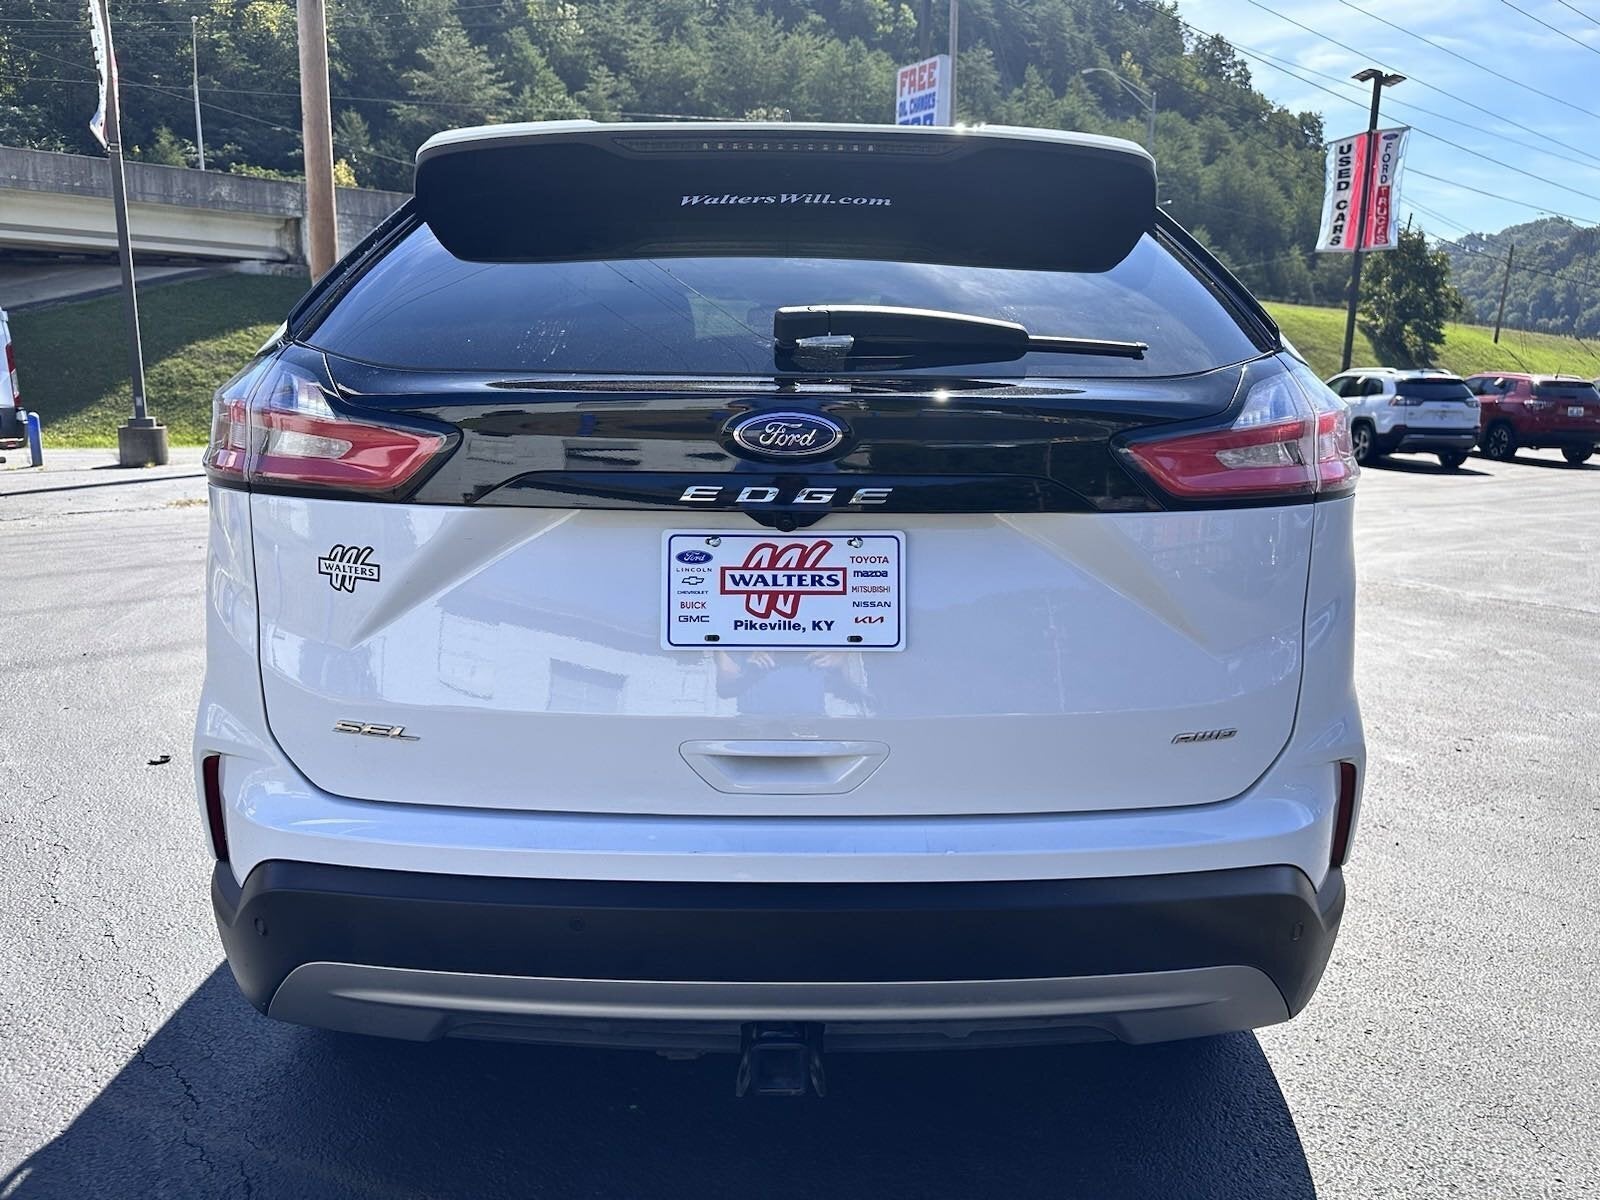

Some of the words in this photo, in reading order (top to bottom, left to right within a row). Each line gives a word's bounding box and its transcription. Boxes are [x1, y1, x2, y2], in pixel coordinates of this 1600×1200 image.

[900, 61, 937, 97] FREE
[1337, 144, 1352, 191] USED
[1380, 142, 1393, 184] FORD
[680, 193, 892, 207] WaltersWill.com
[1330, 200, 1349, 246] CARS
[759, 421, 817, 447] Ford
[679, 485, 894, 505] EDGE
[683, 552, 706, 561] Ford
[849, 555, 890, 564] TOYOTA
[324, 562, 375, 577] WALTERS
[728, 573, 841, 587] WALTERS
[851, 585, 891, 593] MITSUBISHI
[680, 601, 707, 609] BUICK
[852, 600, 892, 608] NISSAN
[678, 615, 710, 623] GMC
[733, 620, 807, 633] Pikeville,
[811, 620, 836, 631] KY
[332, 719, 421, 741] SEL
[1170, 727, 1238, 744] AWD
